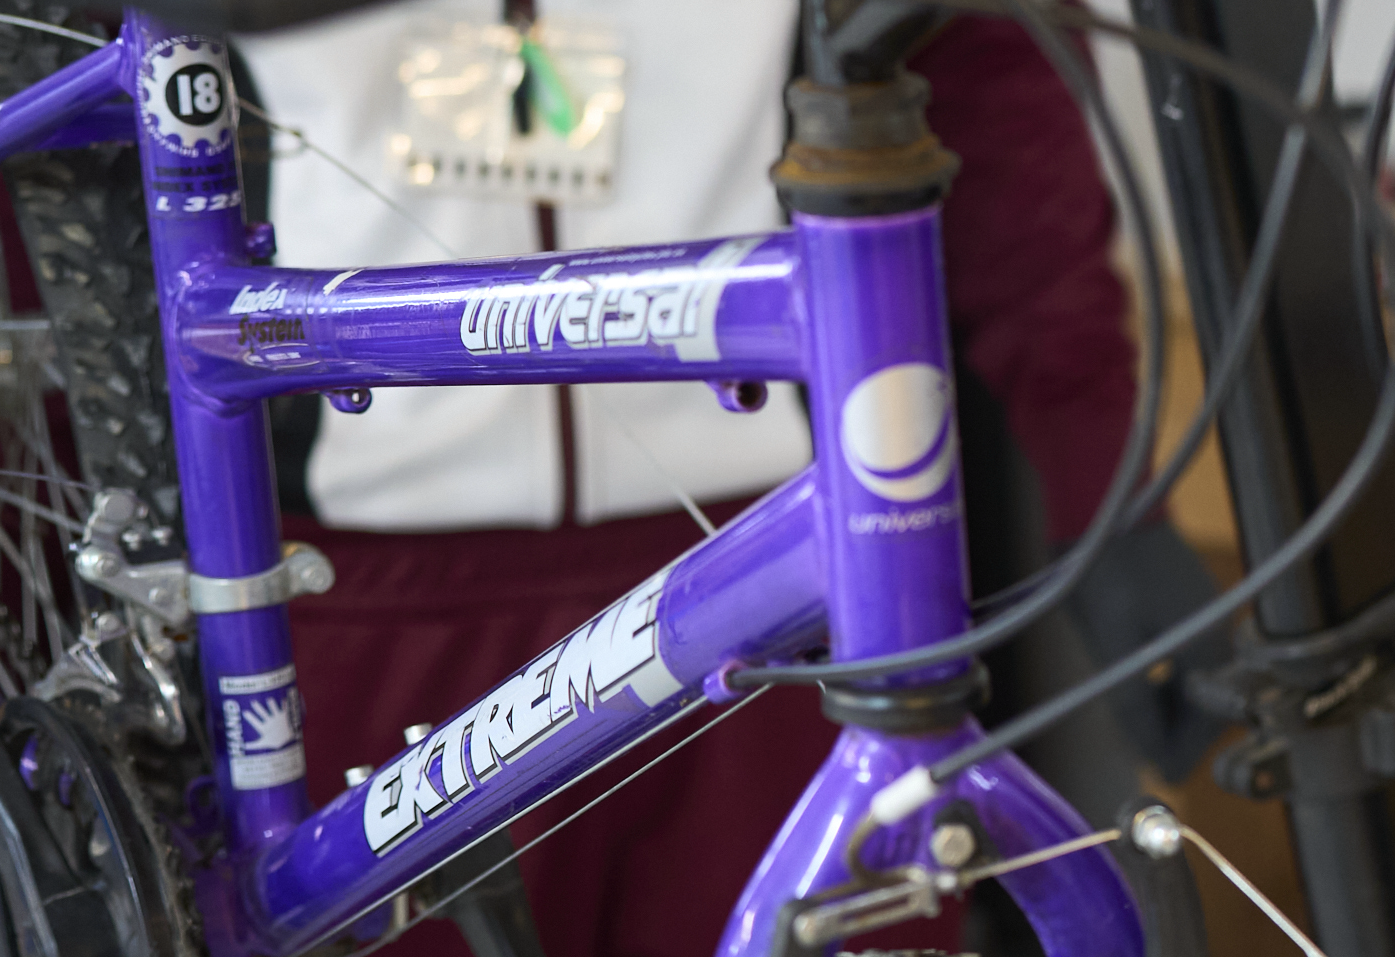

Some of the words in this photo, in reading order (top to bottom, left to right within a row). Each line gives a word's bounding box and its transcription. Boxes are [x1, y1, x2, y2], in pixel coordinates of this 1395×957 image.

[177, 71, 221, 116] 18
[155, 196, 172, 212] L
[229, 282, 288, 315] Index
[238, 316, 305, 353] System
[364, 570, 682, 856] EXTREME
